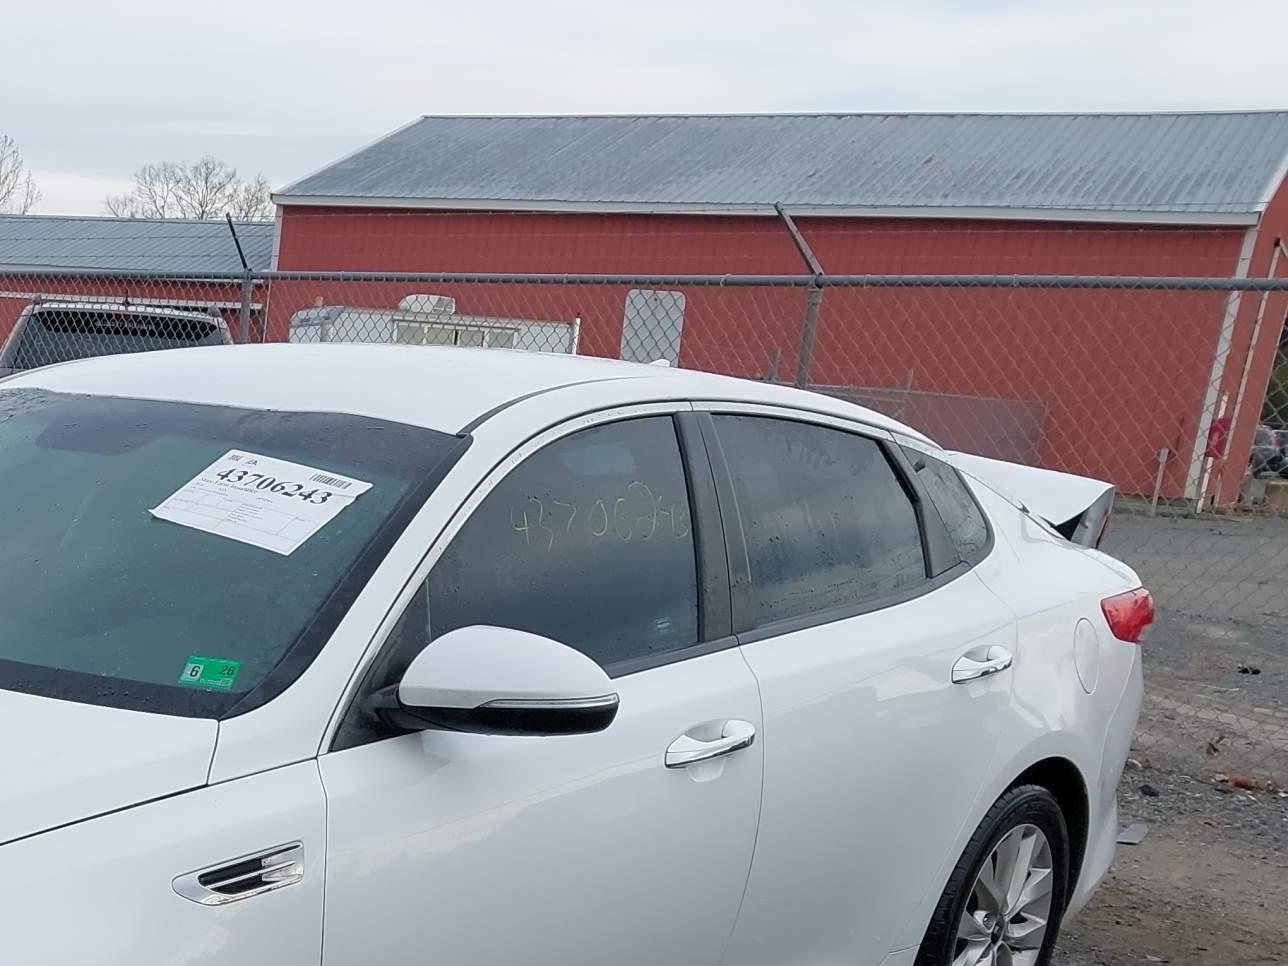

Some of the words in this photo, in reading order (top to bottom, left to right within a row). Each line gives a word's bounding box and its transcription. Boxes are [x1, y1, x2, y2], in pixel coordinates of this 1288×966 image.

[216, 468, 333, 504] 43706243
[190, 665, 201, 677] 6
[219, 664, 236, 676] 26
